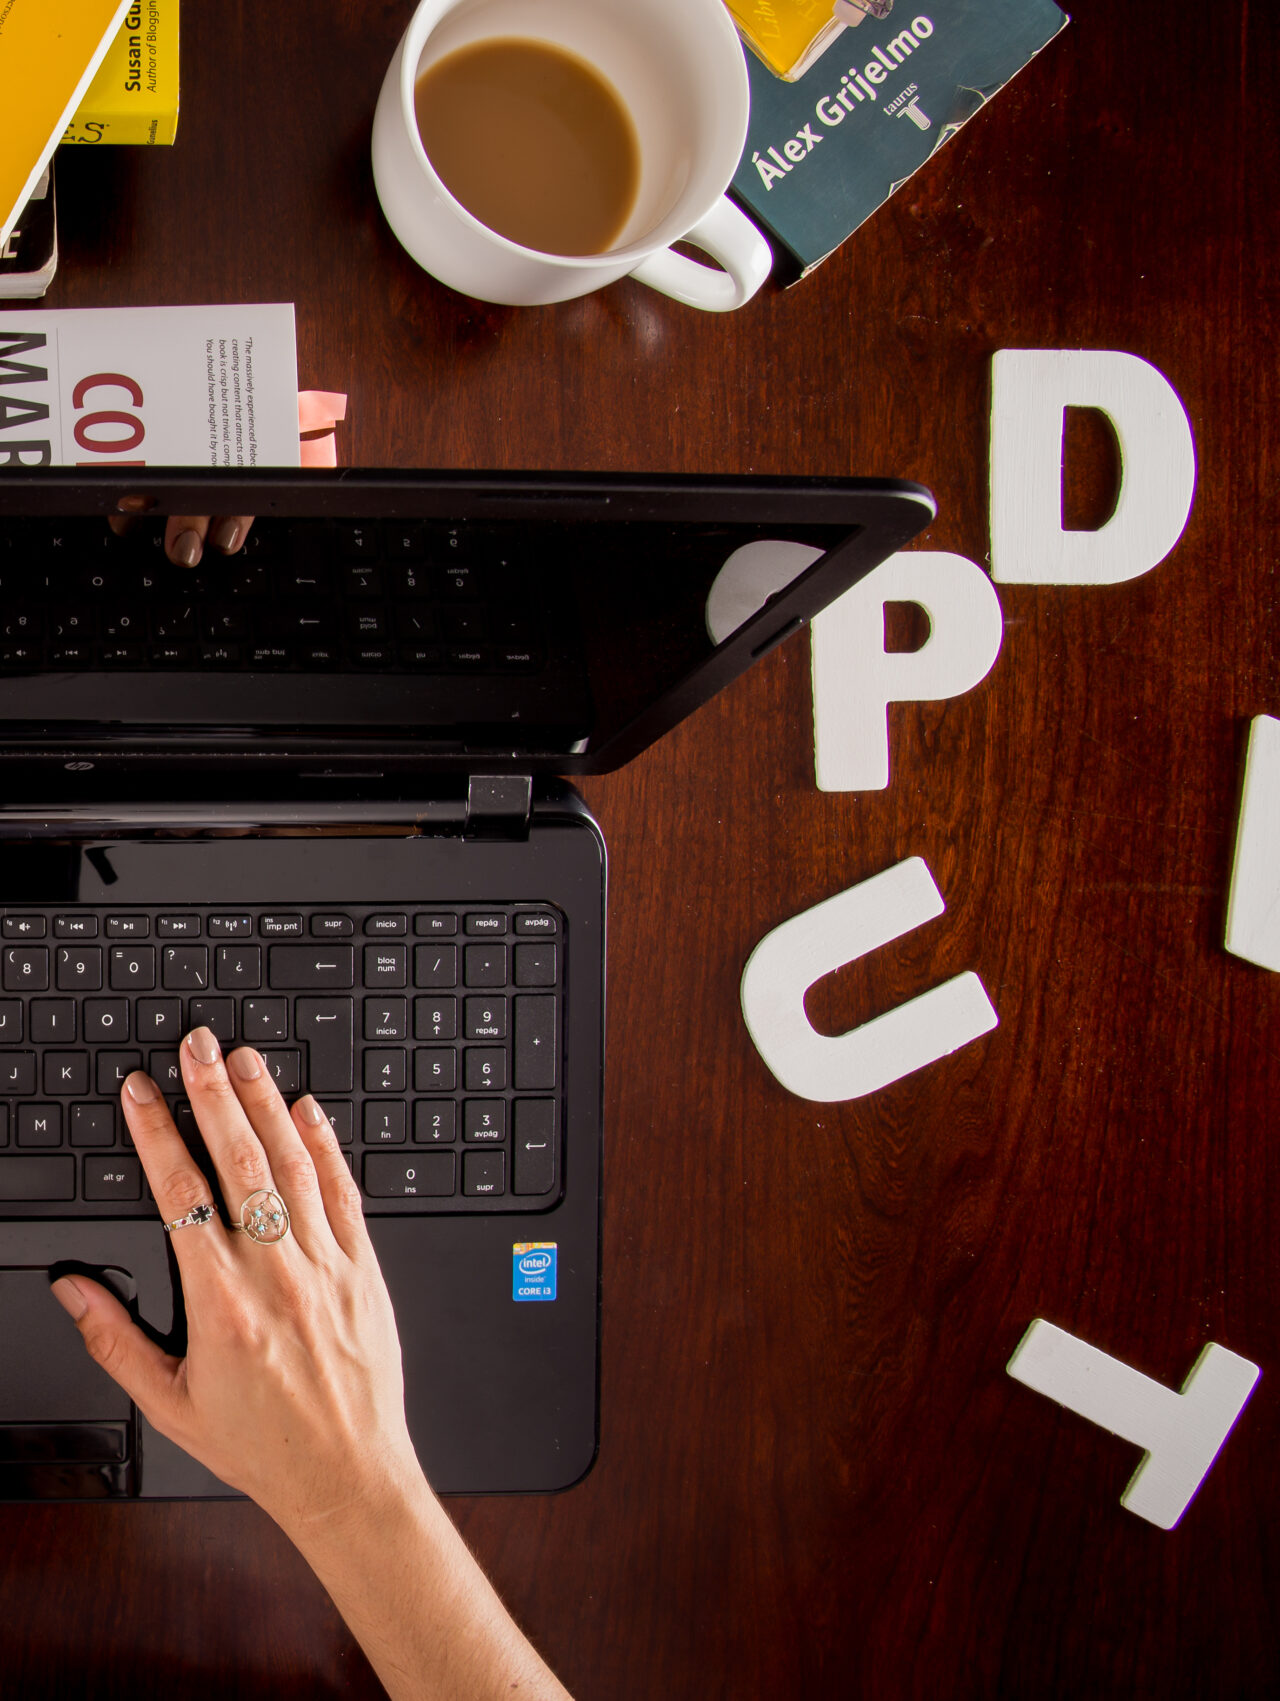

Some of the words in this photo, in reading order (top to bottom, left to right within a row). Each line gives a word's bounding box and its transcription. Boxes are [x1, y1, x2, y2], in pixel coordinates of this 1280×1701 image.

[147, 0, 159, 41] Bloggin
[147, 42, 157, 56] of
[125, 36, 141, 92] Susan
[147, 58, 157, 93] Author
[751, 123, 824, 191] Álex
[815, 15, 935, 127] Grijelmo
[883, 81, 919, 116] taurus
[147, 120, 158, 145] Gunelius
[207, 354, 215, 381] should
[231, 339, 239, 372] creating
[245, 356, 253, 393] massively
[233, 373, 241, 402] content
[73, 372, 146, 467] CO
[208, 402, 217, 433] bought
[246, 394, 256, 442] experienced
[209, 441, 217, 453] by
[235, 418, 243, 452] attracts
[249, 443, 257, 467] Rebec
[23, 963, 31, 973] 8
[77, 963, 84, 973] 9
[378, 957, 395, 967] bloq
[156, 1014, 164, 1025] P
[10, 1068, 17, 1078] J
[63, 1068, 71, 1078] K
[169, 1067, 177, 1077] Ñ
[35, 1120, 46, 1130] M
[523, 1257, 546, 1268] intel
[518, 1287, 542, 1296] CORE
[543, 1287, 551, 1295] i3
